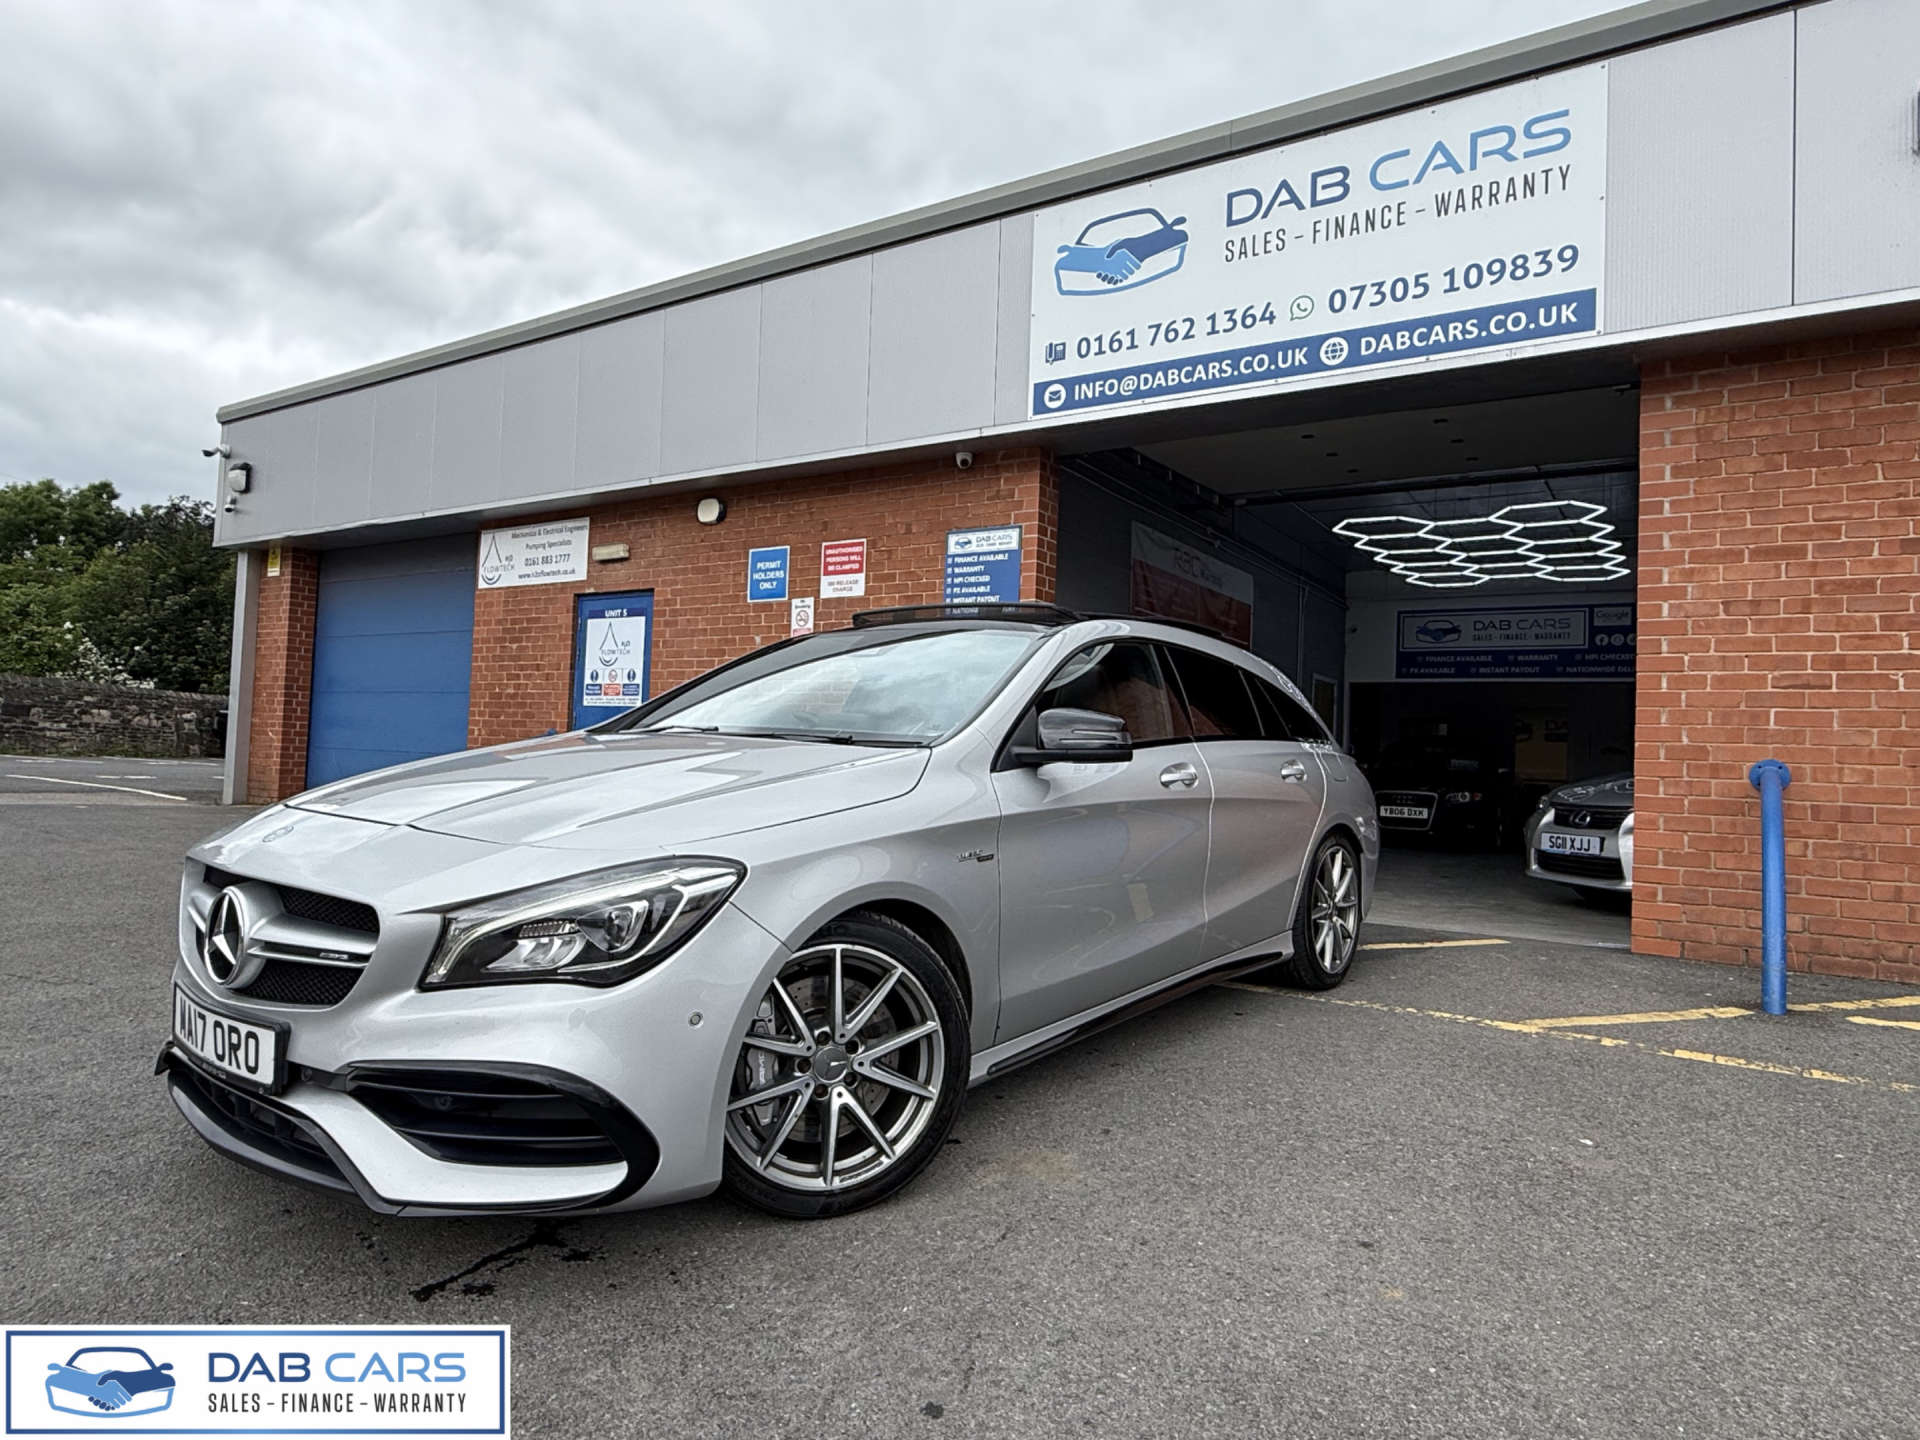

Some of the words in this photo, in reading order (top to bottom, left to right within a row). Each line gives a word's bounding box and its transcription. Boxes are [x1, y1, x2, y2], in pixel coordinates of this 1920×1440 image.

[1226, 166, 1350, 227] DAB
[1369, 109, 1572, 192] CARS
[1224, 228, 1286, 263] SALES
[1312, 201, 1407, 244] FINANCE
[1434, 164, 1571, 218] WARRANTY
[1328, 272, 1430, 314] 07305
[1442, 244, 1579, 294] 109839
[1076, 328, 1139, 359] 0161
[1148, 317, 1196, 346] 762
[1206, 302, 1276, 336] 1364
[1360, 302, 1578, 356] DABCARS.CO.UK
[1074, 347, 1308, 401] INFO@DABCARS.CO.UK
[756, 560, 782, 570] PERMIT
[978, 553, 1009, 562] AVAILABLE
[752, 570, 785, 580] HOLDERS
[759, 581, 777, 590] ONLY
[604, 609, 621, 617] UNIT
[1472, 619, 1512, 631] DAB
[1516, 617, 1571, 630] CARS
[1517, 653, 1558, 661] WARRANTY
[1383, 807, 1406, 816] YB06
[1548, 835, 1568, 849] SG11
[1569, 837, 1592, 852] XJJ
[213, 1019, 259, 1075] ORO
